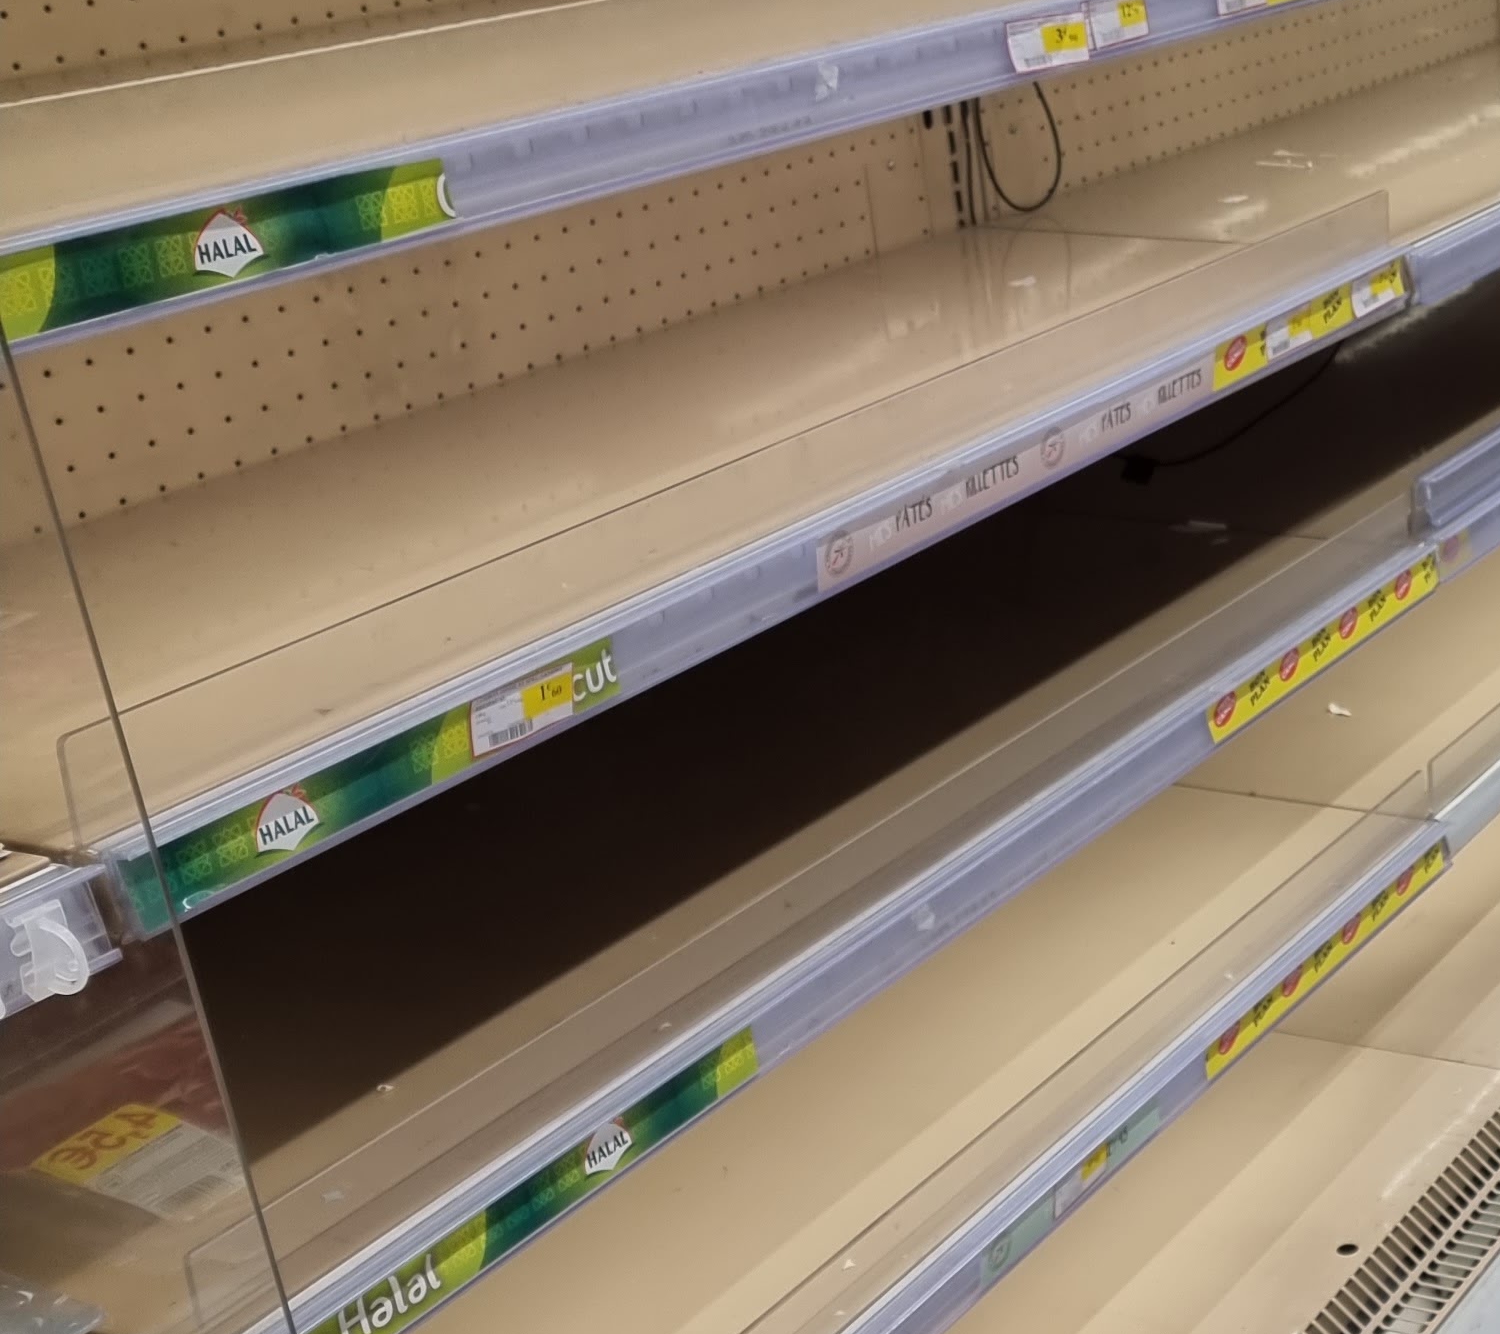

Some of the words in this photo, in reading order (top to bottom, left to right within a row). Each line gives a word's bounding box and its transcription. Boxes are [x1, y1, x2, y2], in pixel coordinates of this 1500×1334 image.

[197, 233, 257, 265] HALAL
[258, 806, 314, 845] HALAL
[587, 1130, 628, 1169] HALAL
